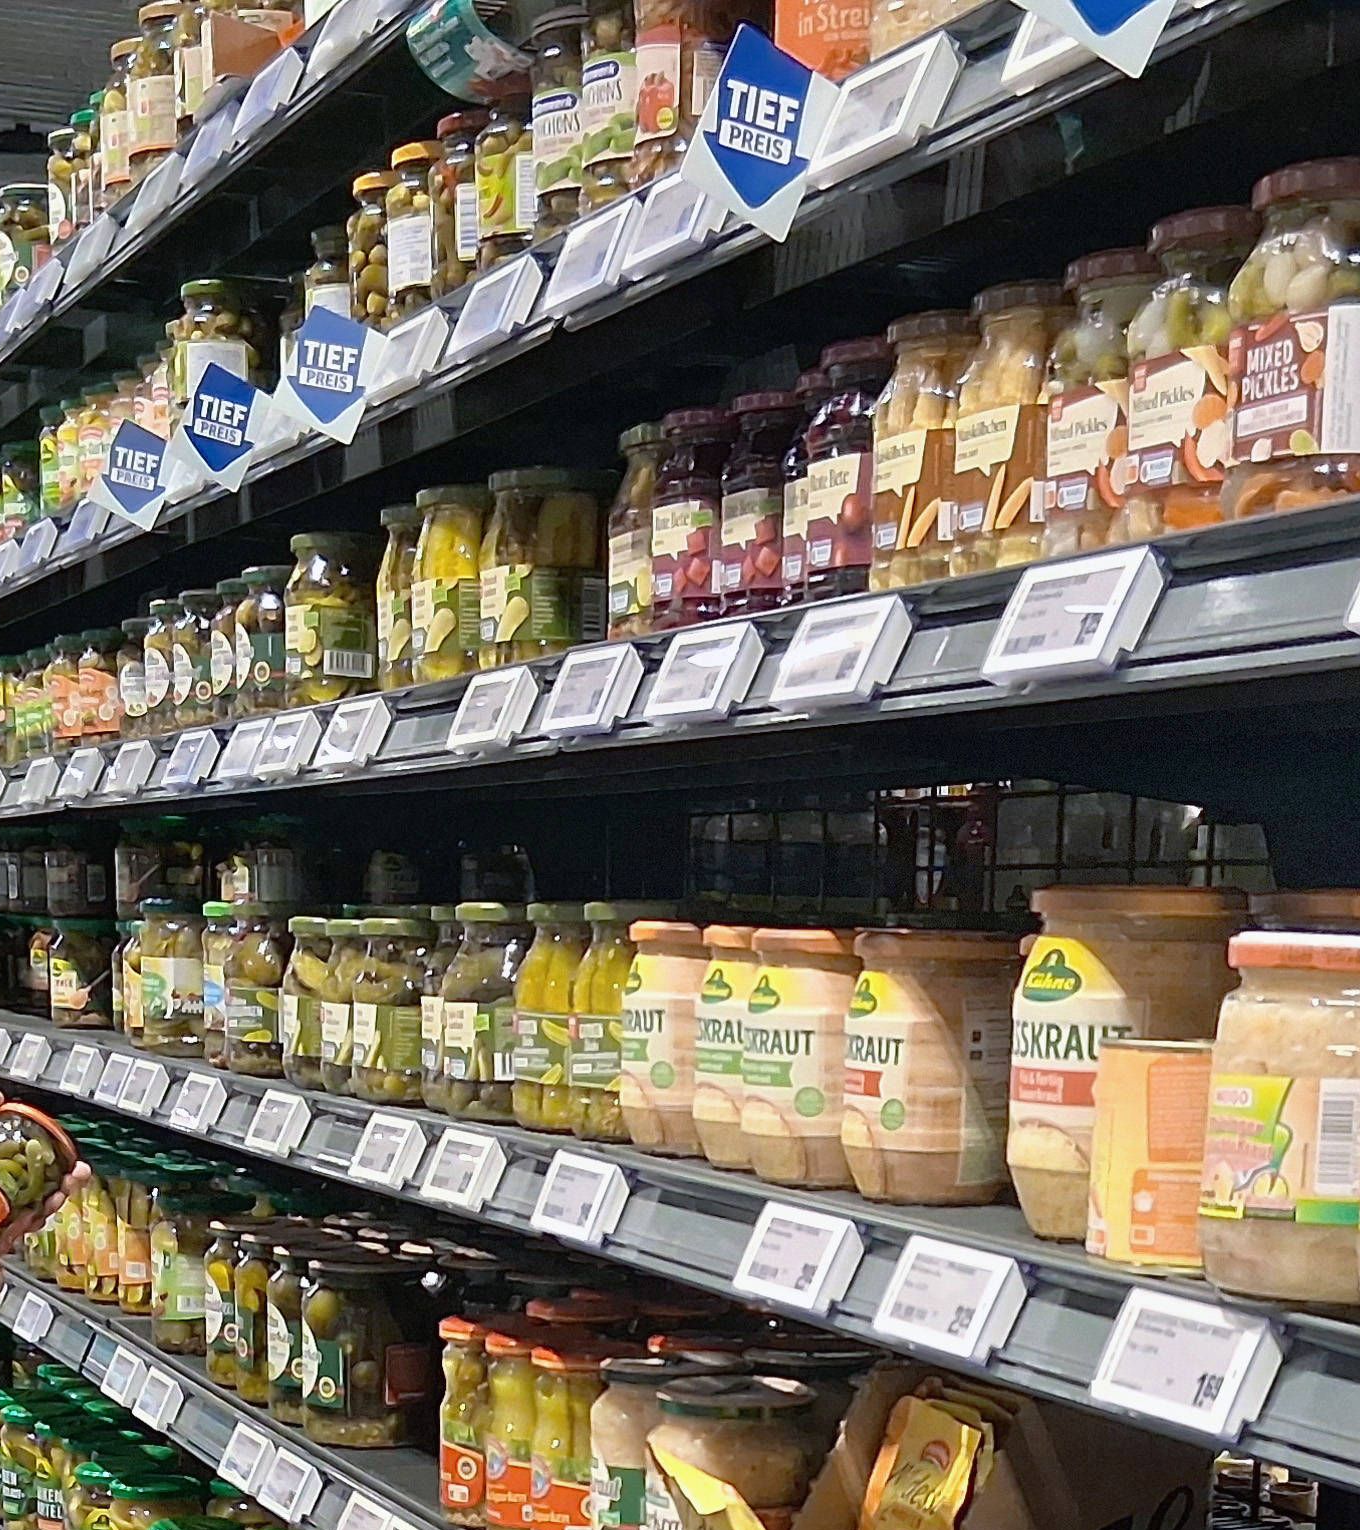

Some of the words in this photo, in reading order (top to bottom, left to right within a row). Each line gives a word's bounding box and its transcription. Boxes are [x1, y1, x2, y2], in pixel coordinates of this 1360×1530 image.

[726, 79, 800, 134] TIEF
[729, 122, 784, 160] PREIS
[303, 340, 358, 373] TIEF
[1246, 339, 1294, 375] MIXED
[306, 368, 349, 391] PREIS
[1159, 385, 1194, 406] Pickles
[1241, 365, 1299, 402] PICKLES
[199, 394, 248, 427] TIEF
[200, 420, 239, 444] PREIS
[115, 447, 160, 475] TIEF
[1025, 969, 1077, 992] Kühne
